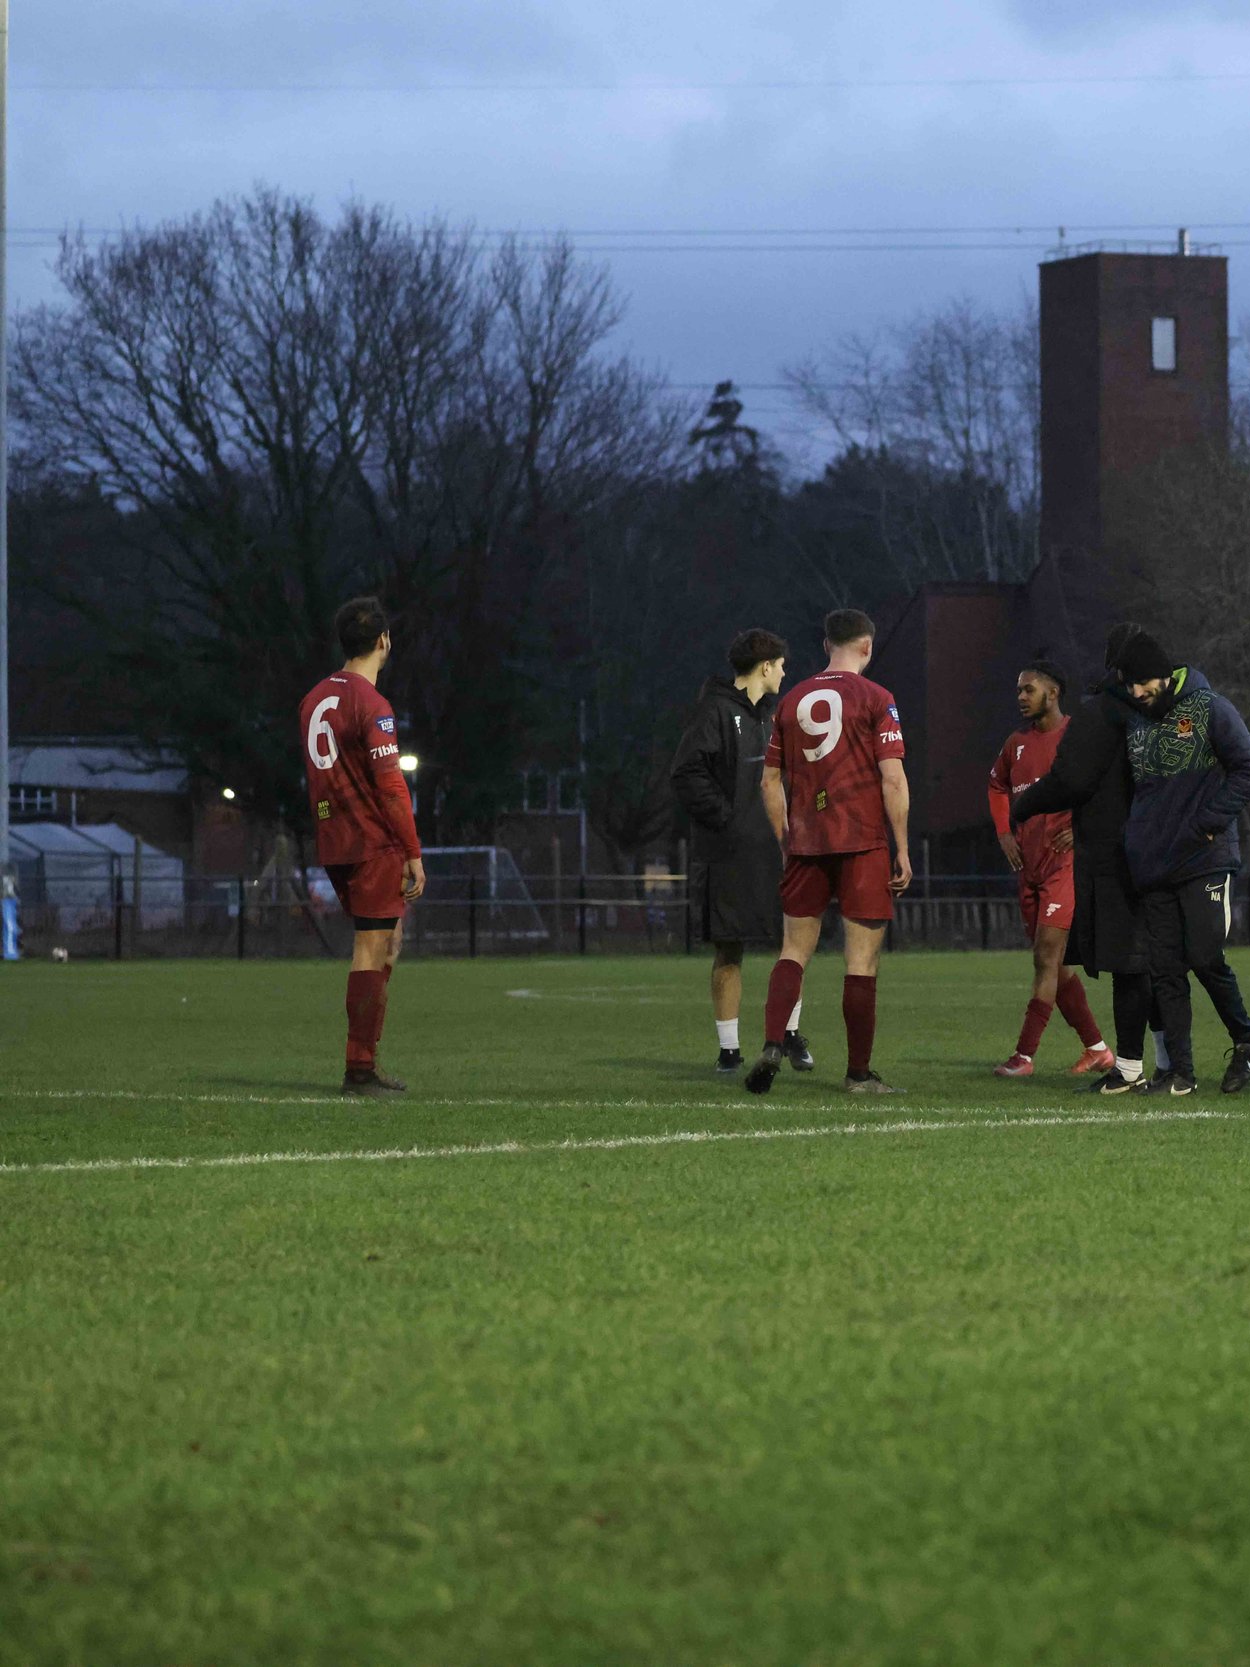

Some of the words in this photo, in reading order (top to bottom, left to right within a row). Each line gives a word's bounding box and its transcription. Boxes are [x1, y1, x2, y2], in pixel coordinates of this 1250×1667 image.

[307, 695, 340, 770] 6
[797, 688, 843, 762] 9
[1210, 891, 1221, 902] NA
